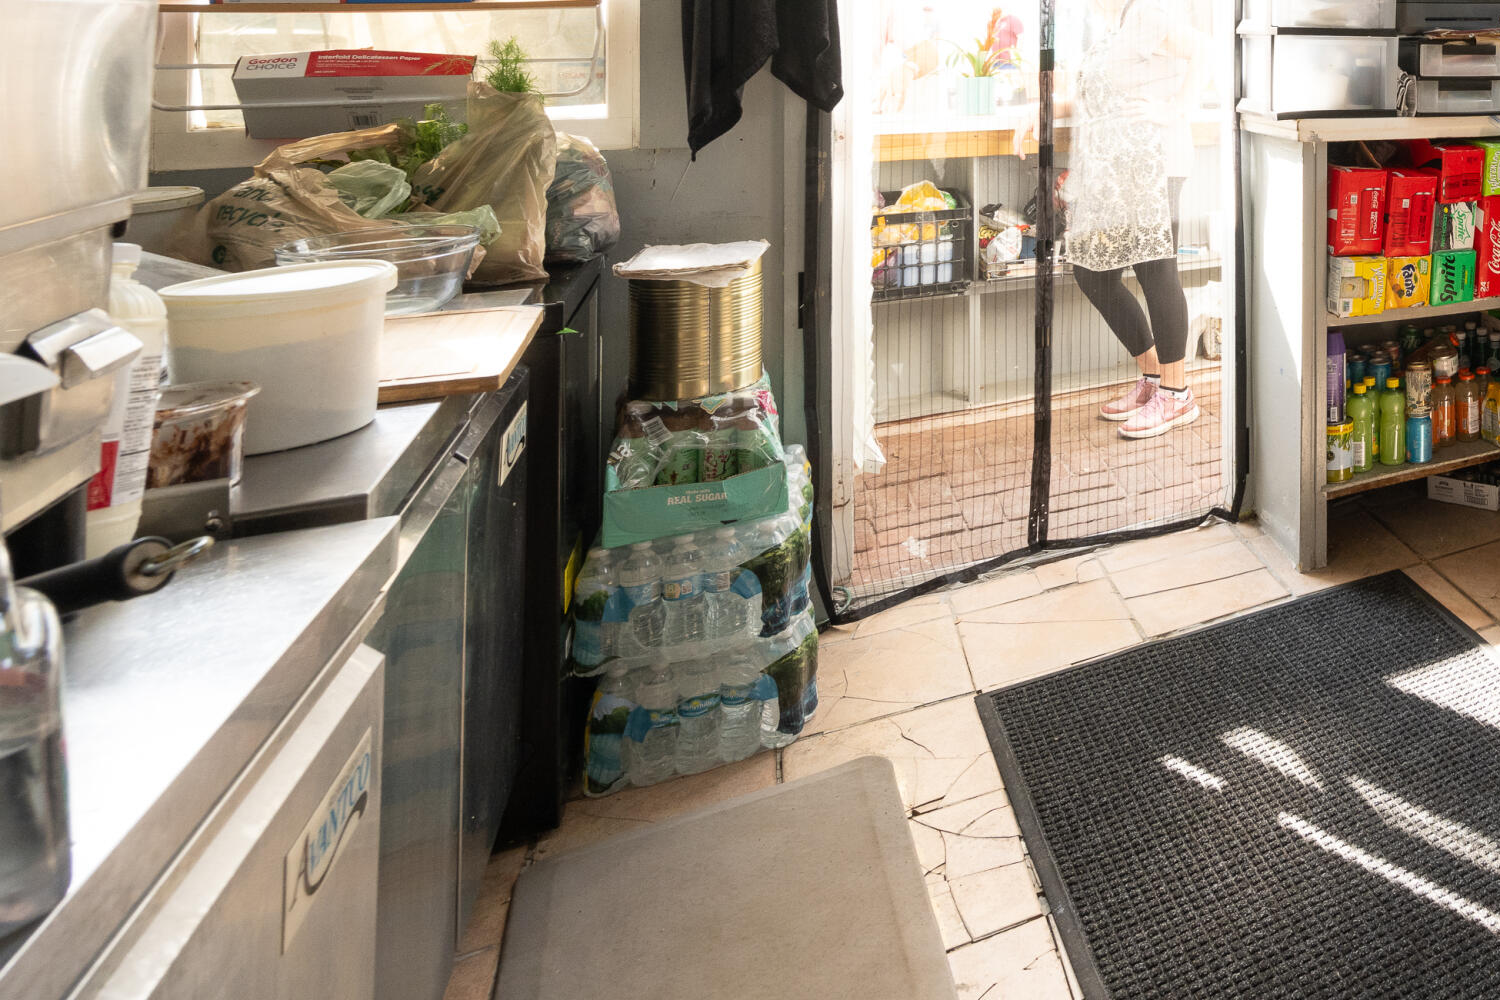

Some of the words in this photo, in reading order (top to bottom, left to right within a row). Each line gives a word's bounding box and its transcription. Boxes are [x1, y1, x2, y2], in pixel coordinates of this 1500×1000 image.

[248, 57, 298, 66] Gordon
[1457, 209, 1466, 246] Sprite
[1401, 264, 1416, 298] Fanta
[1440, 254, 1455, 303] Sprite
[667, 495, 692, 505] REAL
[695, 493, 728, 503] SUGAR
